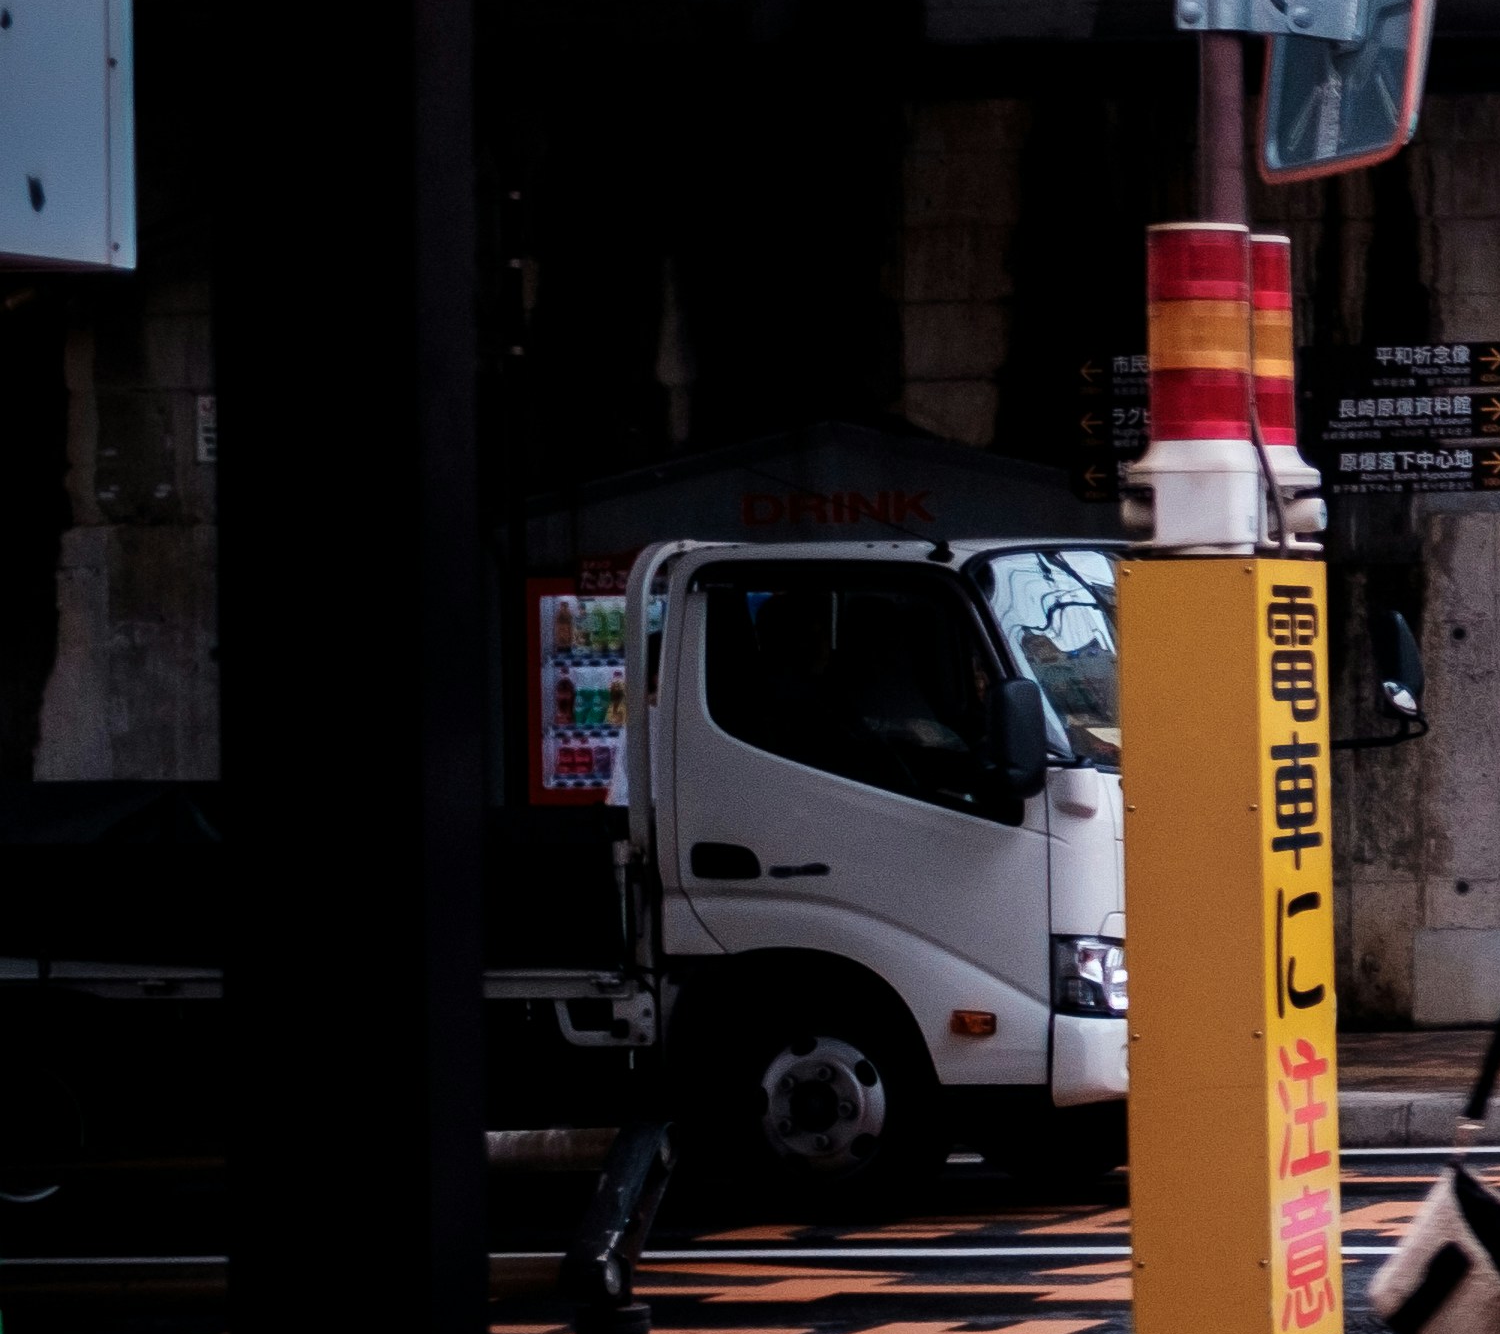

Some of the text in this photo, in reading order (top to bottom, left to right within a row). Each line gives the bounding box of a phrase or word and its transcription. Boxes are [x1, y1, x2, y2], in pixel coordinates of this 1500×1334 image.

[1375, 345, 1471, 366] 平和祈念像
[1338, 396, 1472, 418] 長崎原爆資料館
[1338, 449, 1474, 472] 原爆落下中心地
[742, 491, 934, 525] DRINK
[1268, 585, 1336, 1331] 電車に注意
